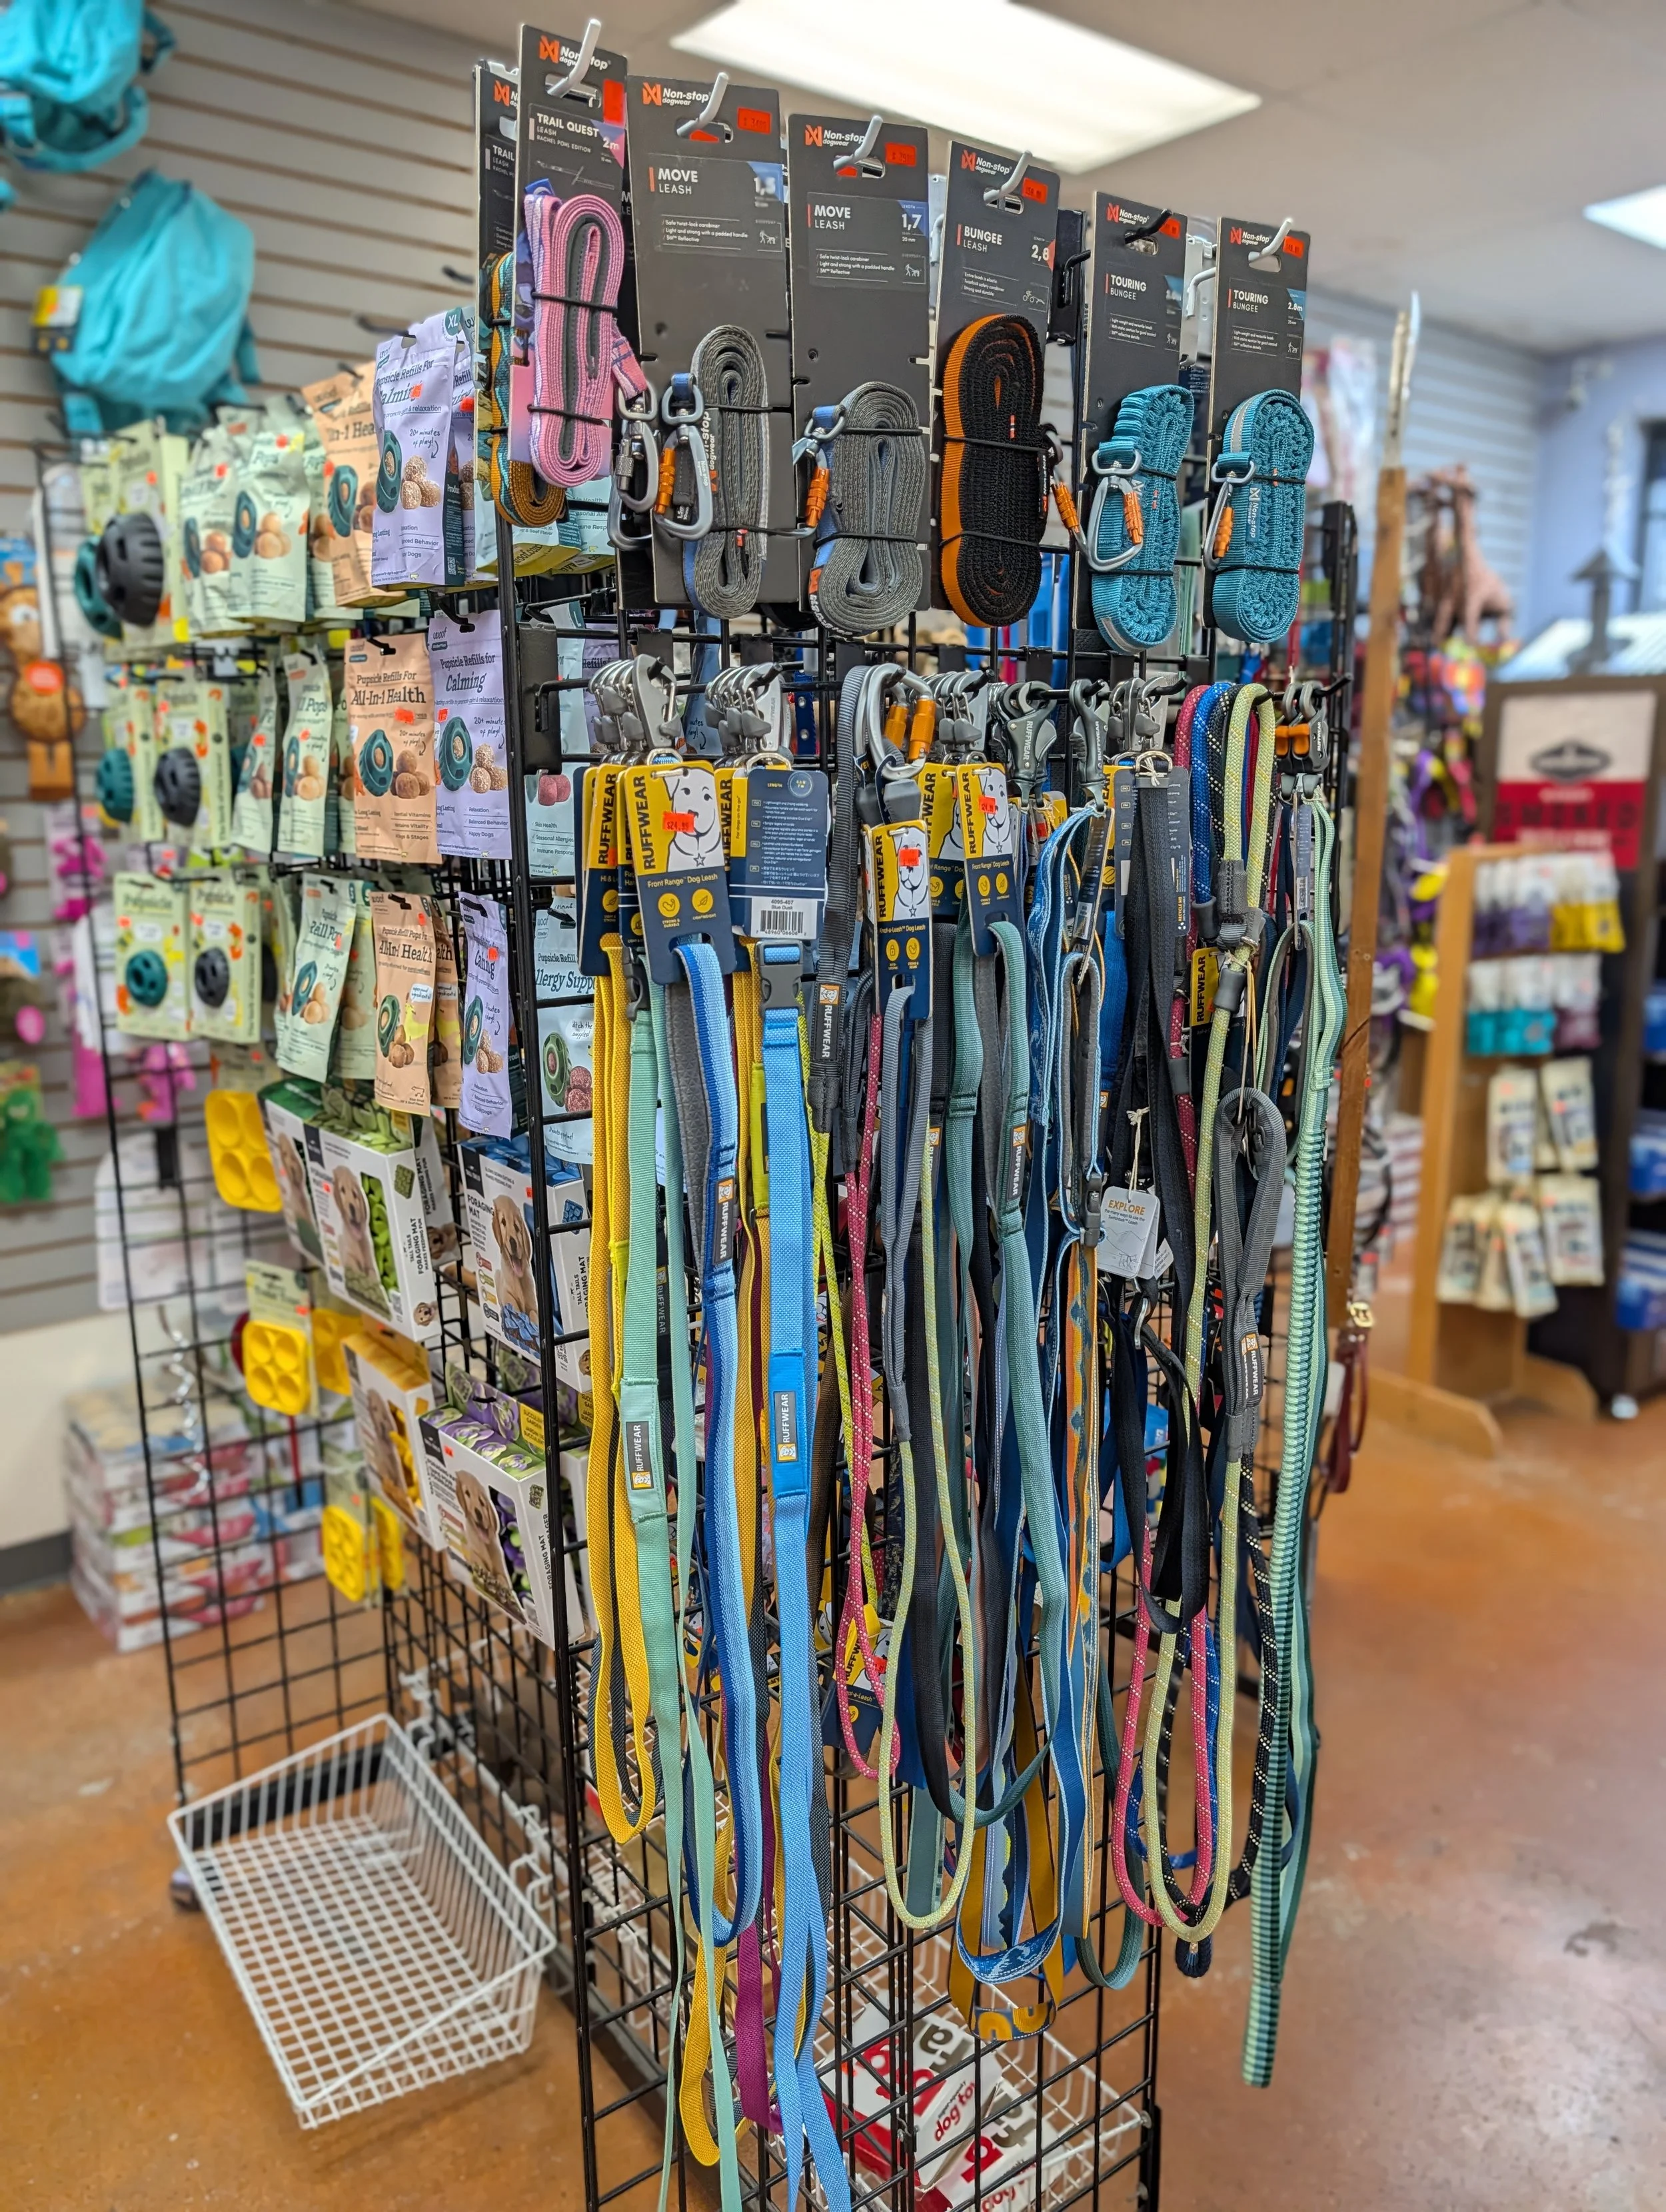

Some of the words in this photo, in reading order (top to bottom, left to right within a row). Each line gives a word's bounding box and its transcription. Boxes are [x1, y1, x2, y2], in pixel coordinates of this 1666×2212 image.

[662, 87, 710, 104] Non-stop
[662, 97, 691, 106] dogwear
[536, 113, 564, 129] TRAIL
[567, 121, 599, 138] QUEST
[536, 126, 556, 137] LEASH
[536, 135, 556, 144] RACHEL
[571, 143, 591, 153] EDITION
[823, 139, 849, 147] dogwear
[824, 129, 866, 144] Non-stop
[492, 145, 515, 162] TRAIL
[492, 157, 509, 168] LEASH
[492, 165, 508, 176] RACHEL
[975, 165, 996, 175] dogwear
[976, 156, 1010, 175] Non-stop
[658, 168, 698, 183] MOVE
[658, 183, 692, 195] LEASH
[814, 205, 851, 219] MOVE
[1120, 209, 1148, 225] Non-stop
[814, 219, 845, 231] LEASH
[902, 214, 922, 231] 1,7
[964, 226, 1003, 245] BUNGEE
[1242, 231, 1270, 244] Non-stop
[963, 240, 988, 253] LEASH
[1031, 245, 1050, 261] 2,8
[1111, 274, 1147, 292] TOURING
[1110, 287, 1136, 300] BUNGEE
[1234, 289, 1269, 304] TOURING
[1233, 301, 1259, 313] BUNGEE
[1287, 302, 1303, 312] 2.8m
[447, 314, 458, 329] XL
[400, 363, 422, 379] Refills
[423, 360, 434, 371] For
[419, 428, 440, 437] minutes
[1250, 502, 1259, 538] Non-stop
[440, 658, 464, 670] Pupsicle
[464, 654, 484, 666] Refills
[485, 652, 495, 664] for
[357, 674, 382, 686] Pupsicle
[383, 672, 403, 682] Refills
[404, 670, 417, 681] For
[445, 672, 486, 693] Calming
[351, 689, 385, 706] All-In-1
[387, 686, 426, 703] Health
[474, 716, 484, 725] 20+
[1023, 720, 1034, 760] RUFFWEAR
[598, 773, 617, 865] RUFFWEAR
[960, 772, 976, 854] RUFFWEAR
[633, 775, 656, 870] RUFFWEAR
[555, 835, 574, 843] Allergies
[687, 875, 700, 885] Dog
[875, 834, 886, 918] RUFFWEAR
[409, 930, 421, 940] Pops
[401, 943, 433, 963] Health
[538, 953, 560, 965] Pupsicle
[560, 953, 576, 963] Refill
[536, 969, 566, 992] llergy
[1196, 955, 1206, 1022] RUFFWEAR
[572, 1020, 584, 1029] ditch
[822, 1005, 832, 1059] RUFFWEAR
[1012, 1145, 1022, 1195] RUFFWEAR
[467, 1193, 494, 1216] FORAGING
[468, 1205, 480, 1219] MAT
[1108, 1199, 1146, 1216] EXPLORE
[719, 1201, 729, 1260] RUFFWEAR
[415, 1235, 424, 1275] FORAGING
[657, 1285, 666, 1335] RUFFWEAR
[781, 1393, 790, 1444] RUFFWEAR
[634, 1424, 644, 1472] RUFFWEAR
[934, 2105, 961, 2141] dog
[958, 2082, 976, 2105] to
